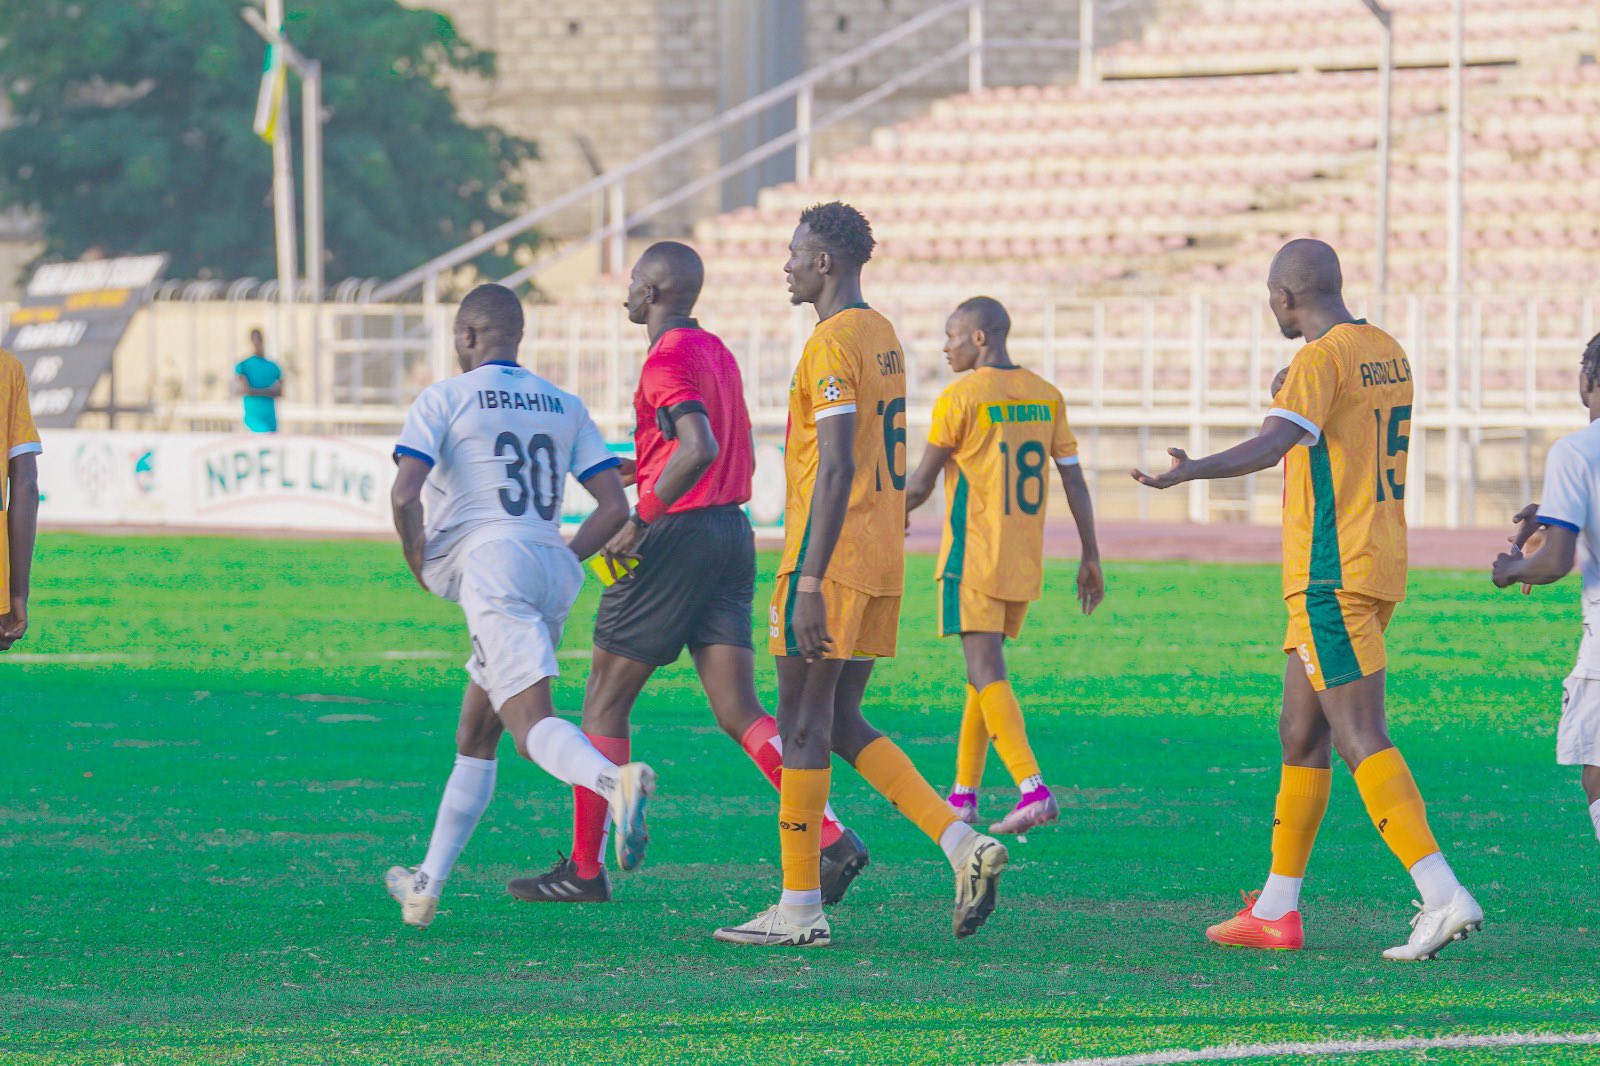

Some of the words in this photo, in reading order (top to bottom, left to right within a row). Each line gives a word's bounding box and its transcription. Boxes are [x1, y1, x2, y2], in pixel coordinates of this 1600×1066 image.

[477, 389, 565, 415] IBRAHIM
[875, 396, 906, 492] 16
[206, 447, 295, 498] NPFL
[309, 449, 375, 503] Live
[495, 431, 559, 522] 30
[999, 439, 1046, 516] 18
[1374, 404, 1412, 503] 15
